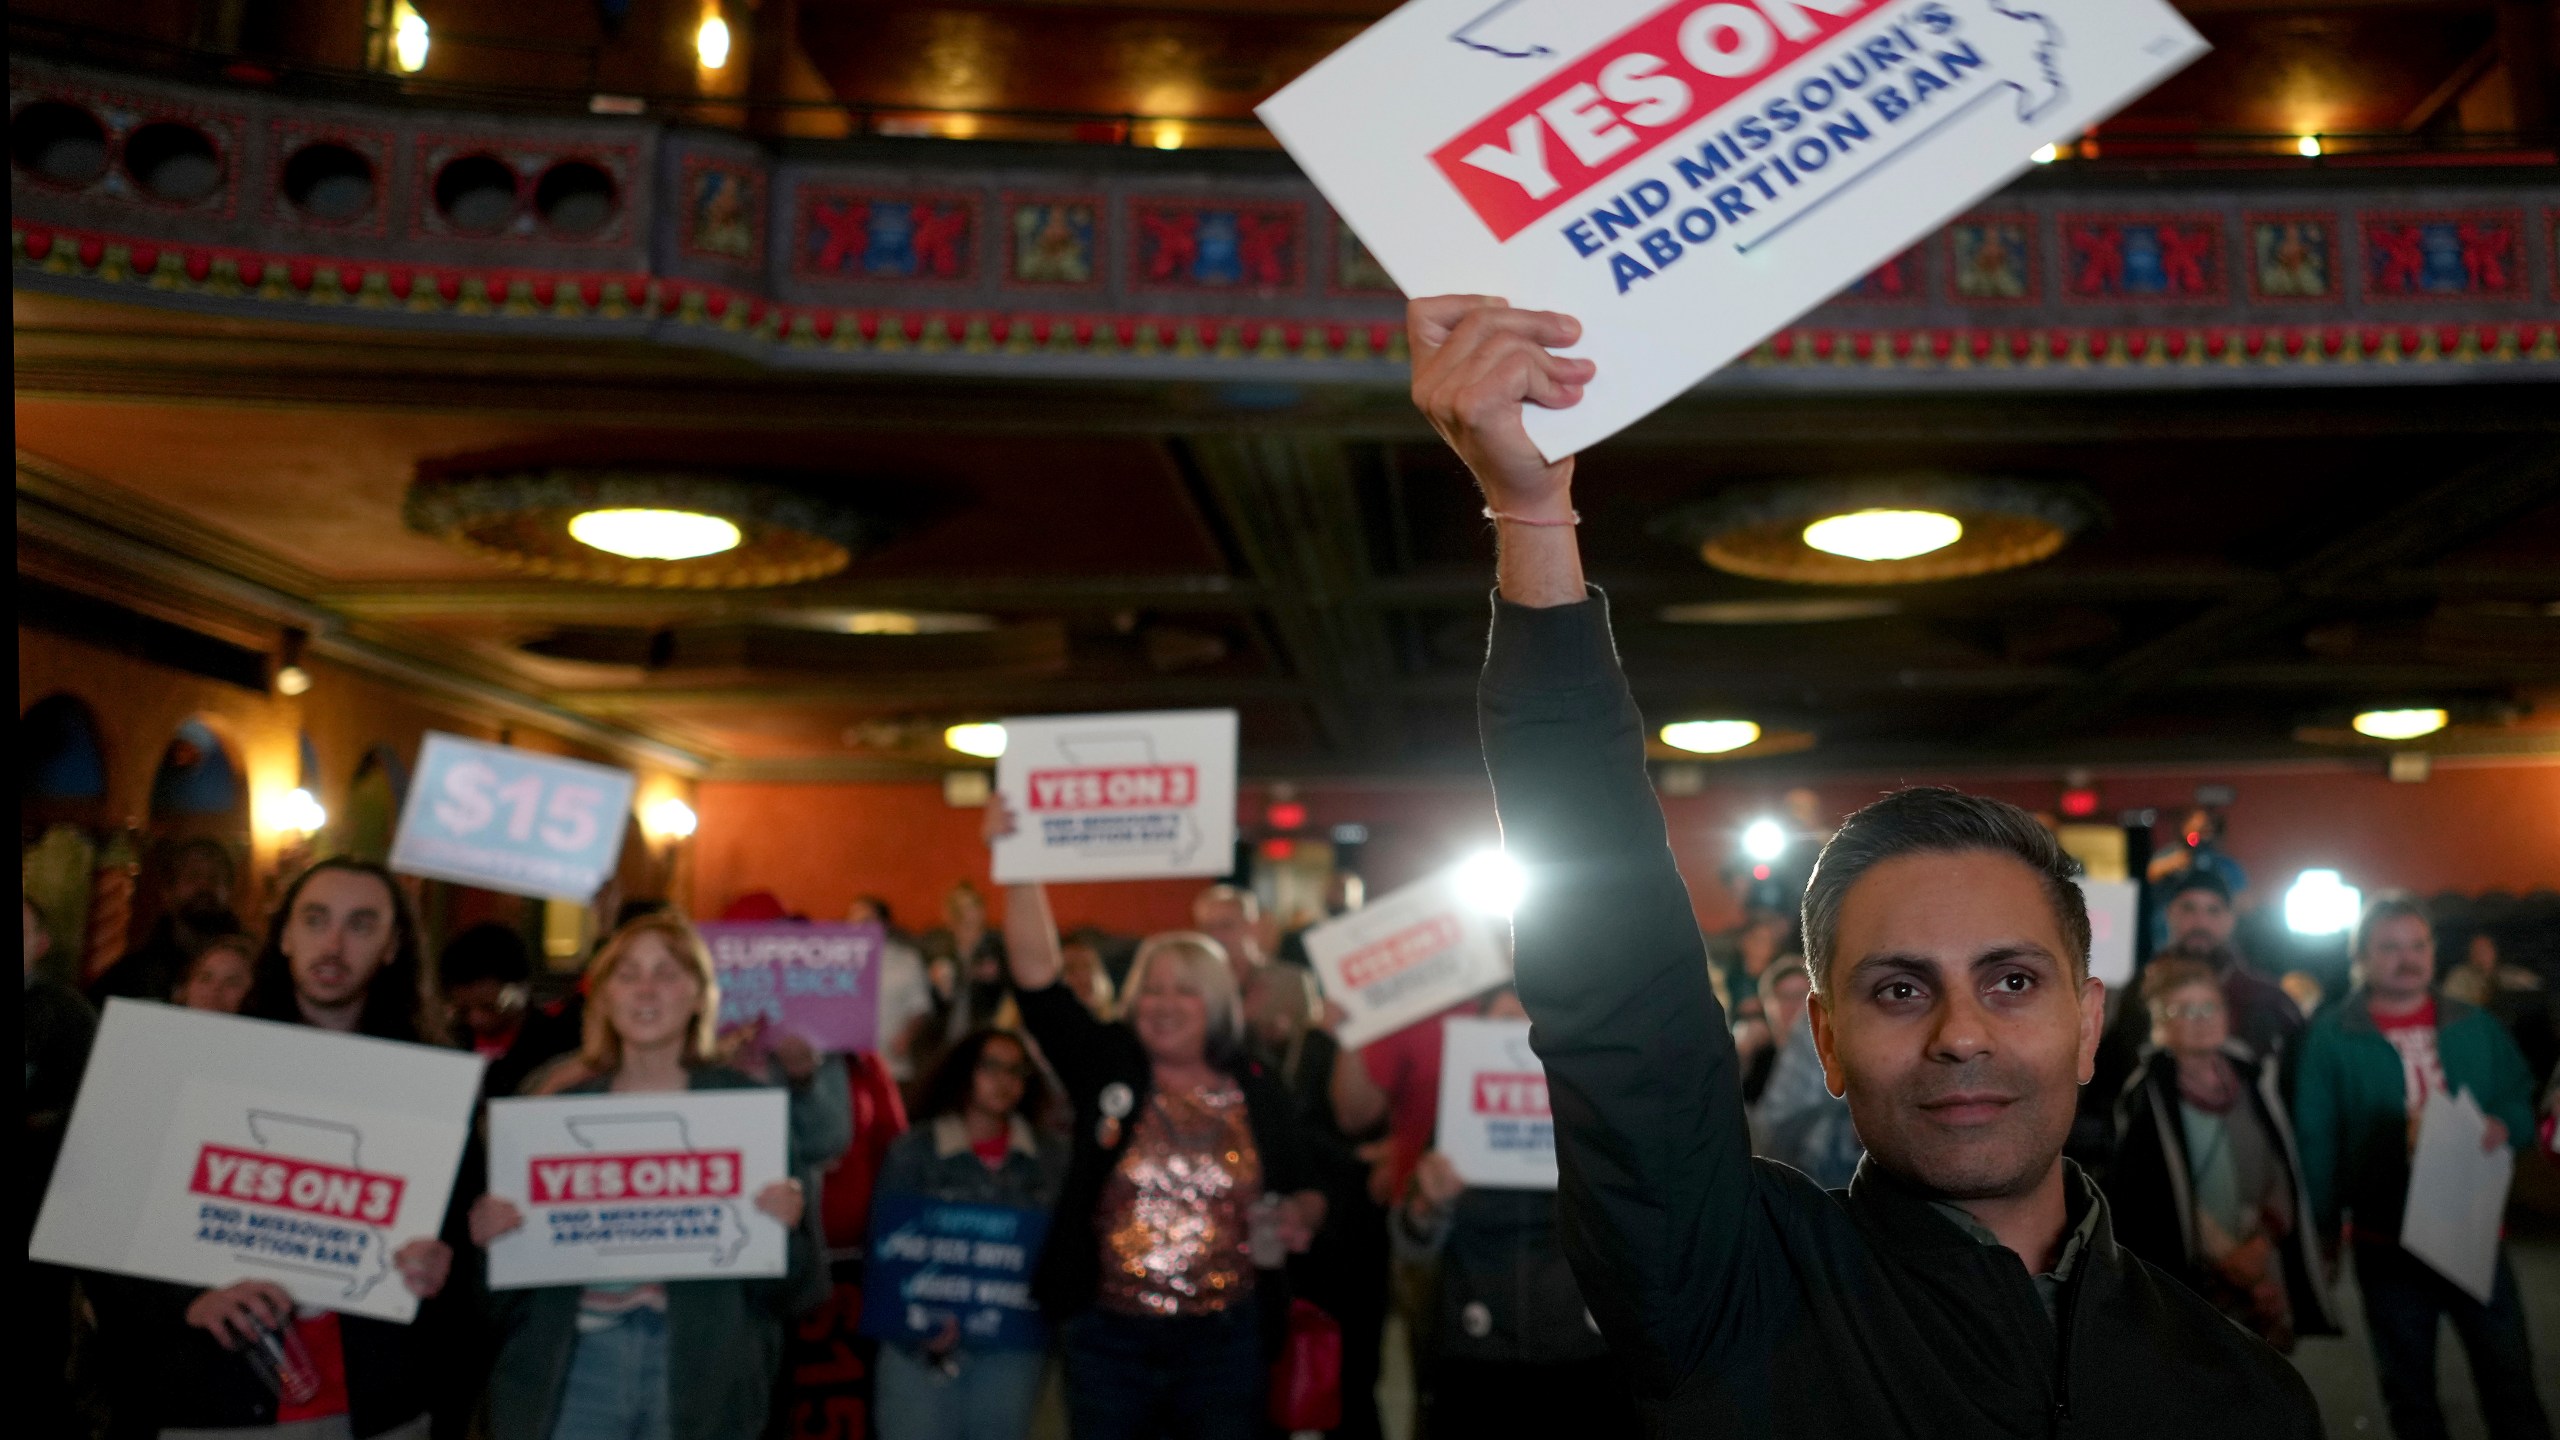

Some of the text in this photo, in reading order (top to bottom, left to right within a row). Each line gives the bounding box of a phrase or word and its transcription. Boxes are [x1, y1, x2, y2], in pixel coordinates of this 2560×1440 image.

[1459, 52, 1695, 201] YES
[1561, 2, 1957, 259] END MISSOURI'S
[1607, 38, 1984, 295] ABORTION BAN
[434, 759, 603, 852] $15
[1037, 776, 1100, 807] YES
[1106, 773, 1162, 804] ON
[715, 935, 872, 969] SUPPORT
[206, 1151, 393, 1222] YES ON 3
[538, 1156, 734, 1198] YES ON 3
